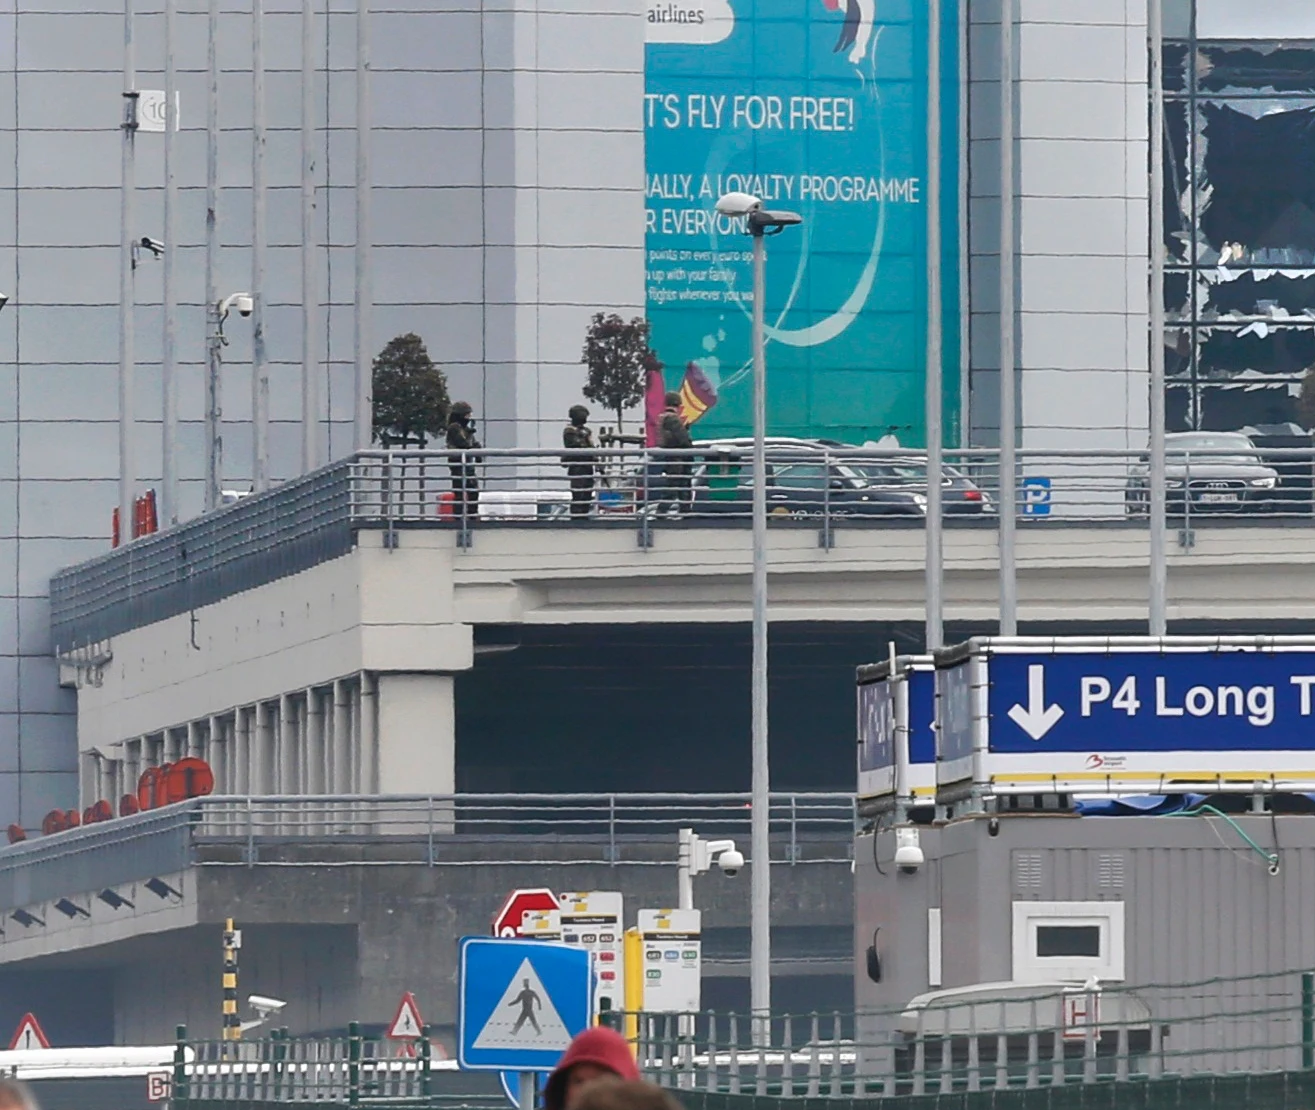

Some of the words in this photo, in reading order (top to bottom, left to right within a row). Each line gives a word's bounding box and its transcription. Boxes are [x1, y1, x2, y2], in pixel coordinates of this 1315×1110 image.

[647, 4, 705, 24] airlines
[688, 95, 724, 128] FLY
[733, 96, 782, 129] FOR
[790, 97, 854, 131] FREE!
[698, 174, 713, 198] A
[717, 174, 794, 201] LOYALTY
[800, 175, 920, 203] PROGRAMME
[662, 208, 752, 236] EVERYON
[1026, 484, 1048, 513] P
[1080, 675, 1141, 717] P4
[1155, 675, 1275, 726] Long
[152, 1077, 164, 1097] B
